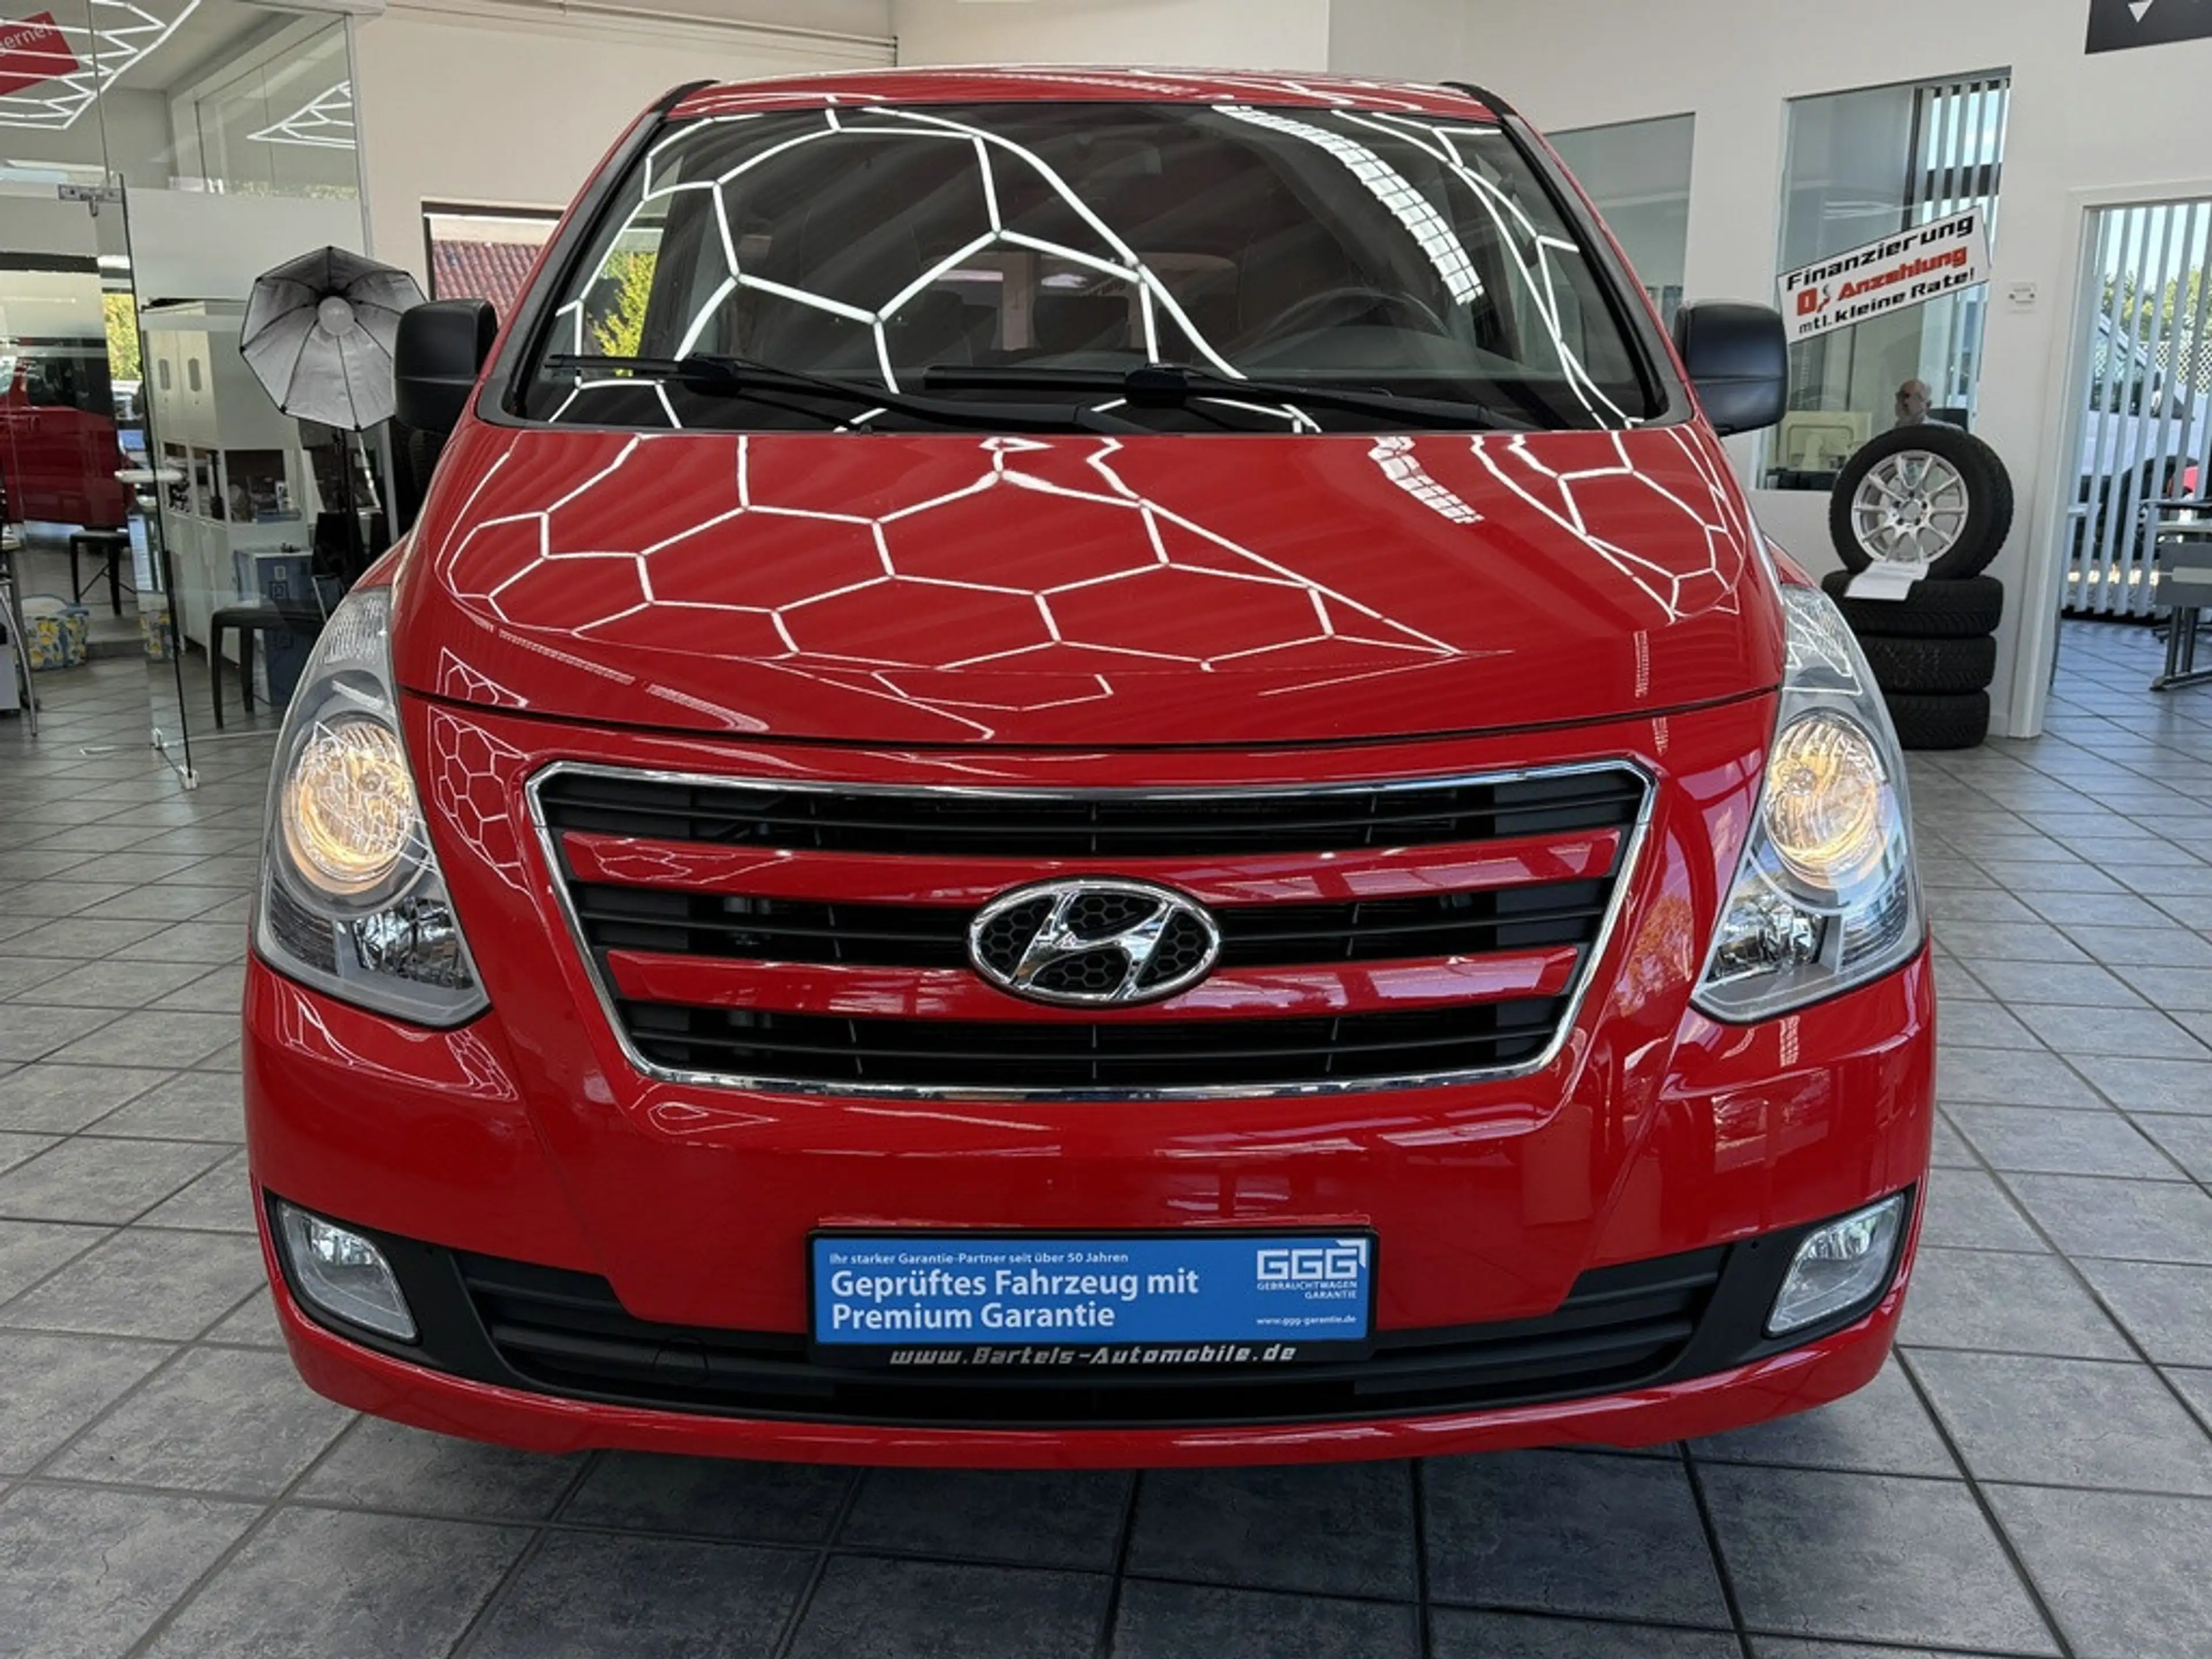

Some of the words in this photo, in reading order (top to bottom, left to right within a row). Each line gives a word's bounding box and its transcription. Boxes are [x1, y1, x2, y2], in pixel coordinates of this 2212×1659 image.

[1787, 215, 1974, 291] Finanzierung
[1838, 247, 1968, 301] Anzahlung
[1835, 292, 1906, 323] kleine
[1911, 267, 1975, 298] Rate!
[830, 1253, 848, 1264] Ihr
[851, 1253, 895, 1264] starker
[898, 1252, 1006, 1264] Garantie-Partner
[1008, 1252, 1032, 1263] seit
[1035, 1252, 1065, 1263] über
[1067, 1253, 1084, 1263] 50
[1085, 1252, 1128, 1263] Jahren
[1257, 1248, 1358, 1280] GGG
[831, 1268, 987, 1303] Geprüftes
[995, 1268, 1138, 1301] Fahrzeug
[1147, 1267, 1199, 1294] mit
[1257, 1281, 1358, 1290] GEBRAUCHTWAGEN
[1304, 1290, 1358, 1300] GARANTIE
[832, 1302, 972, 1329] Premium
[981, 1301, 1115, 1328] Garantie
[1256, 1314, 1358, 1327] www.ggg-garantie.de
[890, 1344, 1297, 1365] www.Bartels-Automobile.de
